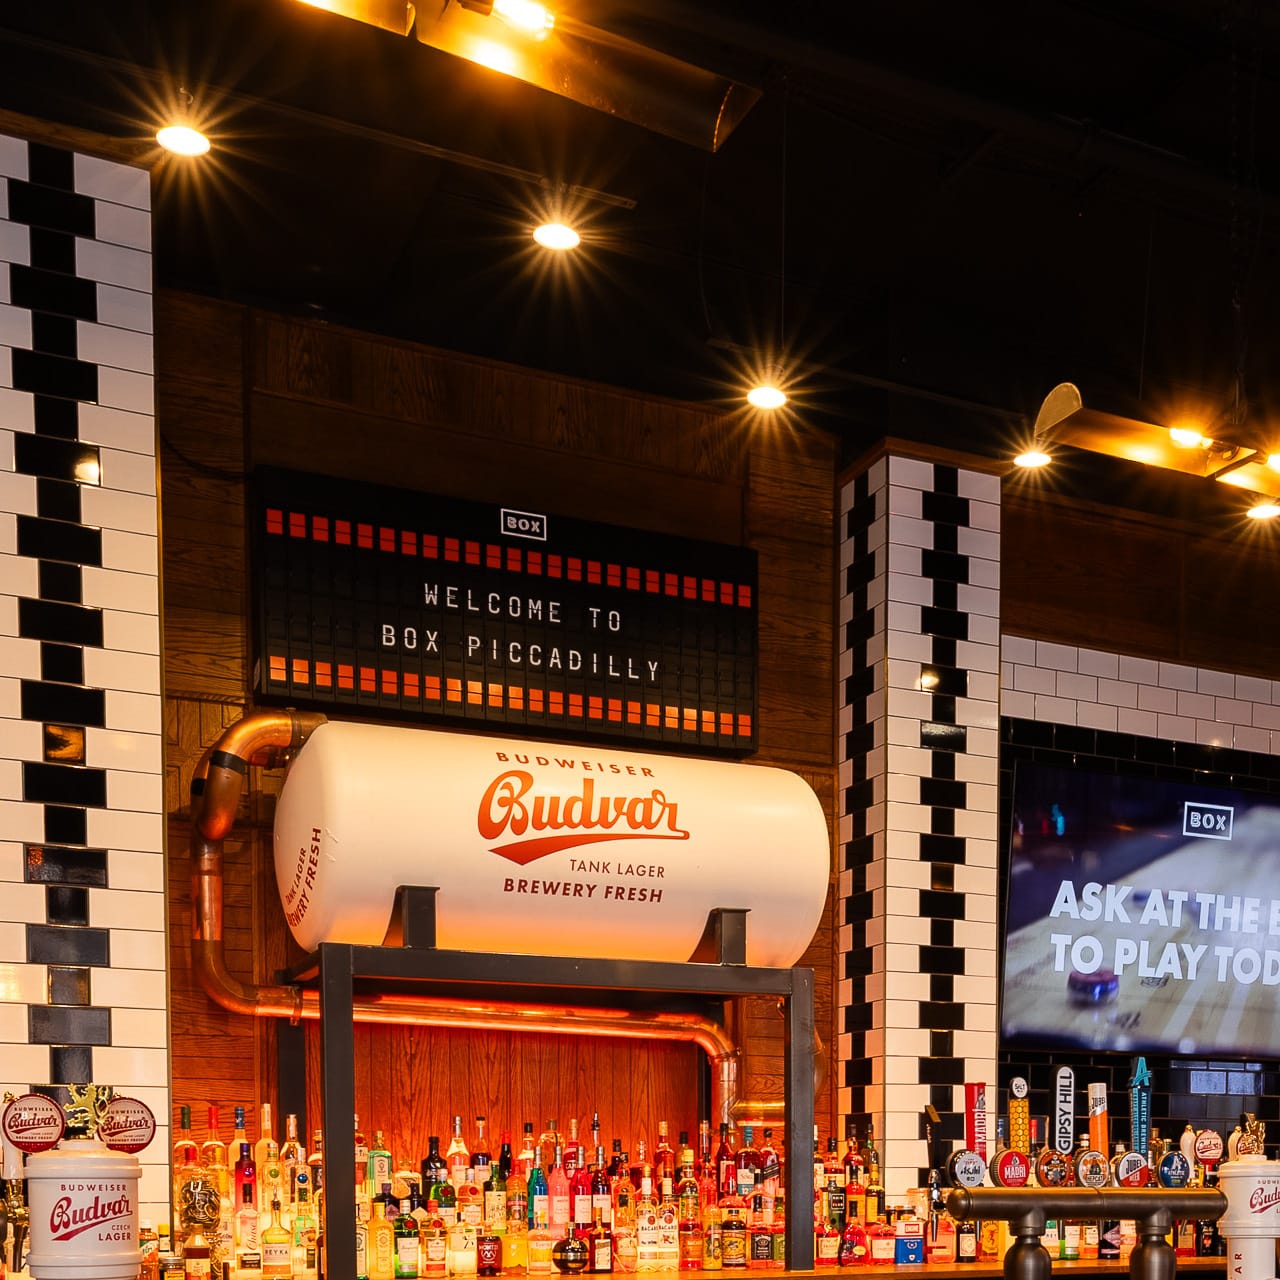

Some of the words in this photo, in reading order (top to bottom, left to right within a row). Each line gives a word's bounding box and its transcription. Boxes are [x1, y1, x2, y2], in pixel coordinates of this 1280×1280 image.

[506, 516, 540, 533] BOX
[424, 583, 561, 624] WELCOME
[589, 607, 622, 632] TO
[382, 625, 438, 654] BOX
[468, 636, 659, 682] PICCADILLY
[496, 752, 656, 777] BUDWEISER
[477, 769, 690, 841] Budvar
[1190, 810, 1227, 831] BOX
[294, 847, 307, 888] LAGER
[305, 827, 321, 891] FRESH
[569, 858, 611, 875] TANK
[617, 863, 665, 878] LAGER
[503, 878, 598, 898] BREWERY
[604, 885, 664, 903] FRESH
[1049, 880, 1134, 924] ASK
[1139, 888, 1188, 928] AT
[1195, 892, 1261, 934] THE
[1050, 933, 1104, 975] TO
[1113, 938, 1208, 981] PLAY
[1059, 1072, 1073, 1104] HILL
[7, 1112, 60, 1129] Budvar
[1140, 1091, 1148, 1123] ATHLETIC
[100, 1115, 151, 1132] Budvar
[1058, 1107, 1072, 1152] GIPSY
[960, 1165, 981, 1175] Asahi
[50, 1194, 133, 1233] Budvar
[98, 1232, 131, 1240] LAGER
